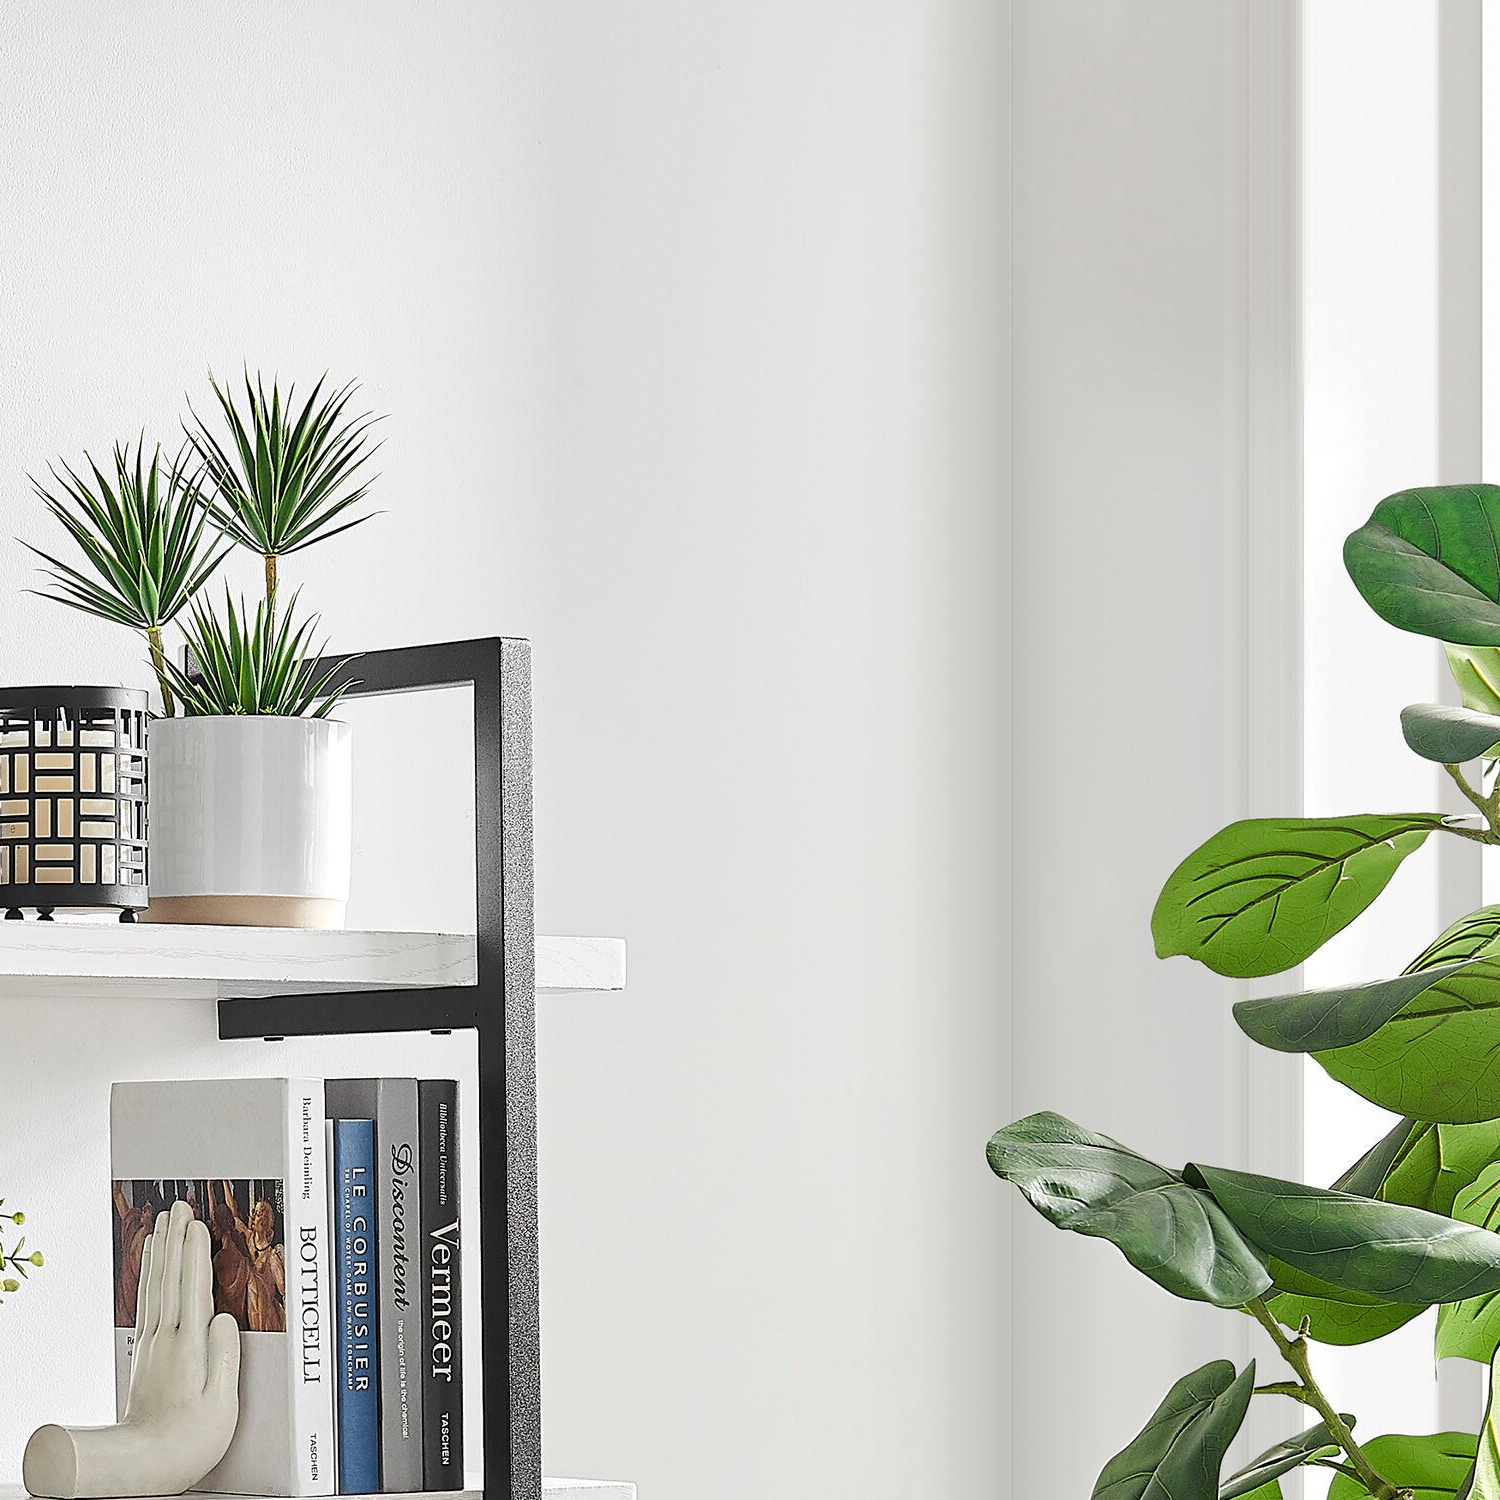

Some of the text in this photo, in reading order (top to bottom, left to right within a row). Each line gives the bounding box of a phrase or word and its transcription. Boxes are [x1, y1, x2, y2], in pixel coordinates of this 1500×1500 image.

[301, 1097, 313, 1200] Barbara Deimling
[439, 1102, 448, 1152] Bibliotheca
[345, 1222, 351, 1233] OF
[391, 1143, 415, 1312] Discontent
[352, 1167, 369, 1391] LE CORBUSIER
[429, 1217, 460, 1382] Vermeer
[299, 1226, 321, 1385] BOTTICELLI
[397, 1334, 405, 1356] origin
[399, 1357, 406, 1366] of
[401, 1403, 409, 1439] chemical
[440, 1412, 450, 1466] TASCHEN
[309, 1432, 319, 1481] TASCHEN
